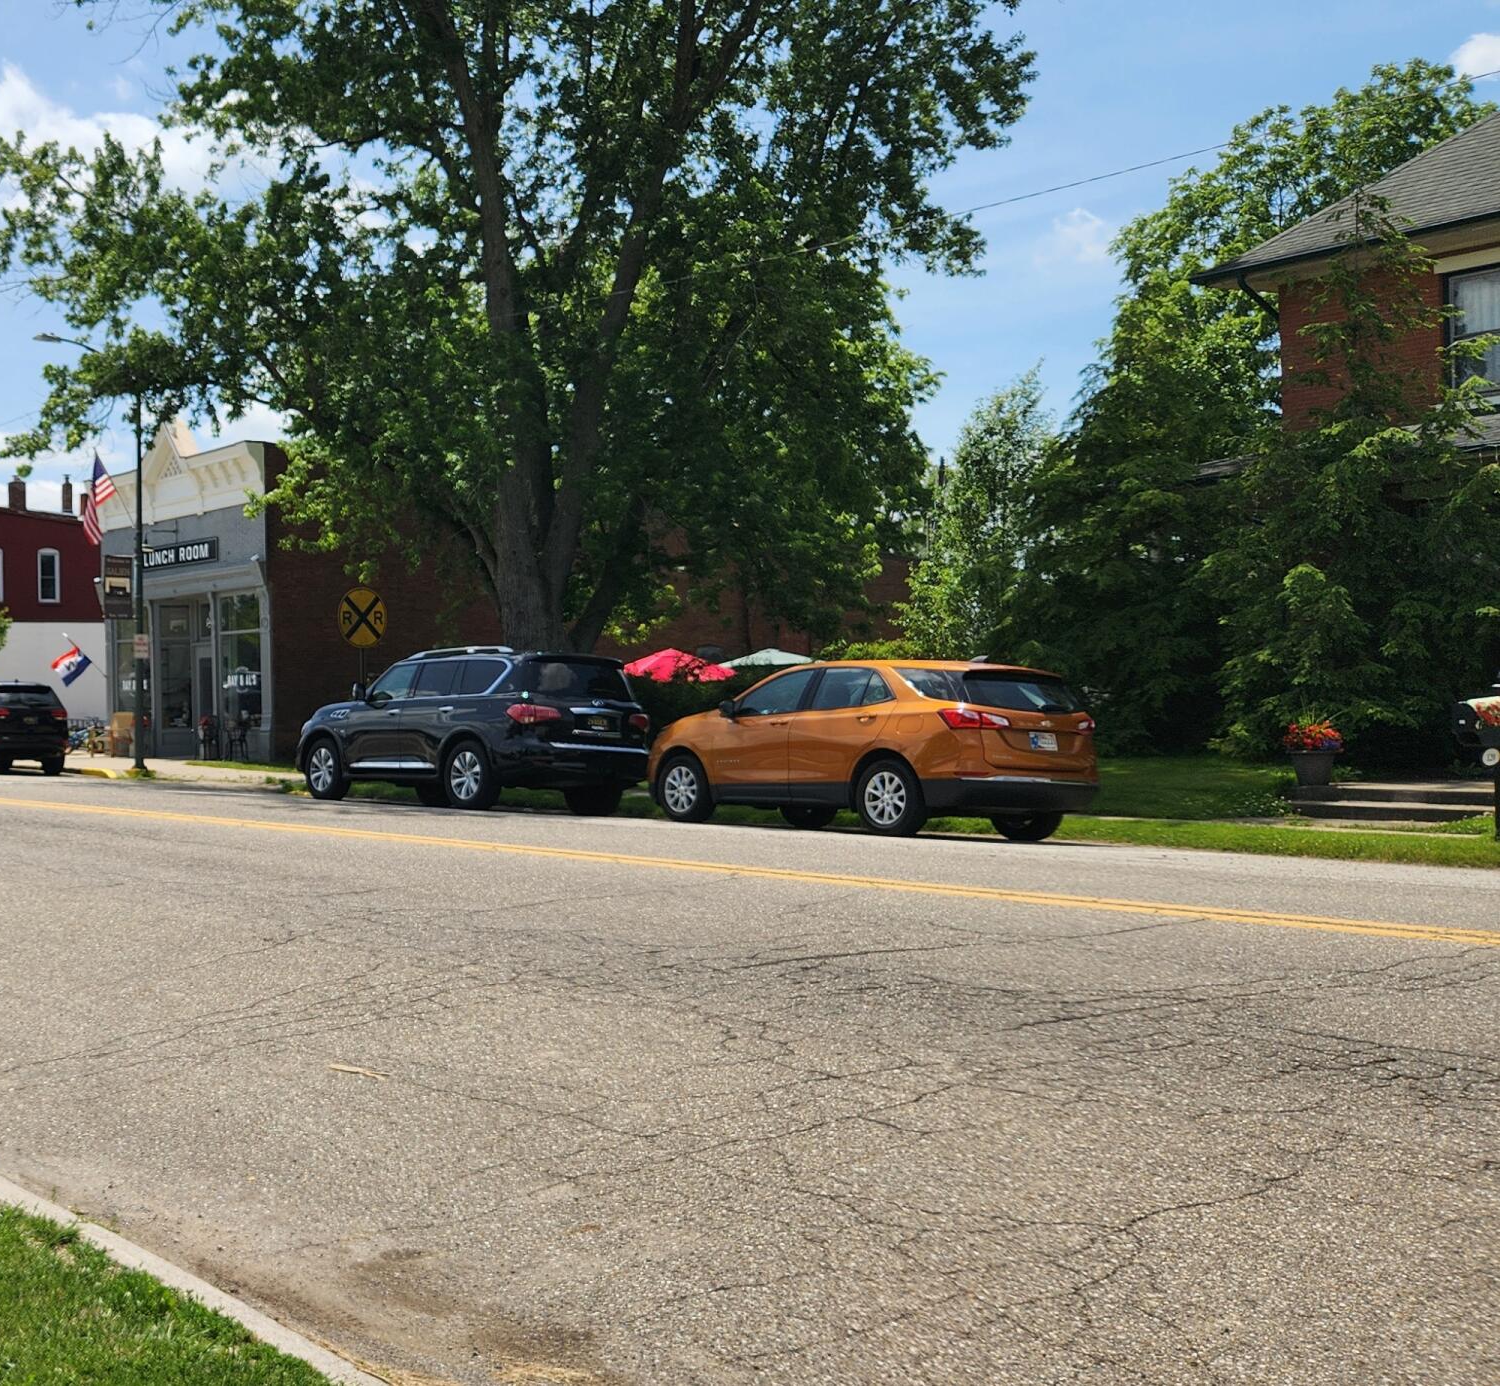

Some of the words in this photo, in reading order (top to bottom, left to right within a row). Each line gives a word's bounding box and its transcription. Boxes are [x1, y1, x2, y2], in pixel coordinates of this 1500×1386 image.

[143, 549, 175, 567] LUNCH
[179, 543, 210, 561] ROOM
[342, 611, 352, 625] R
[373, 611, 383, 625] R
